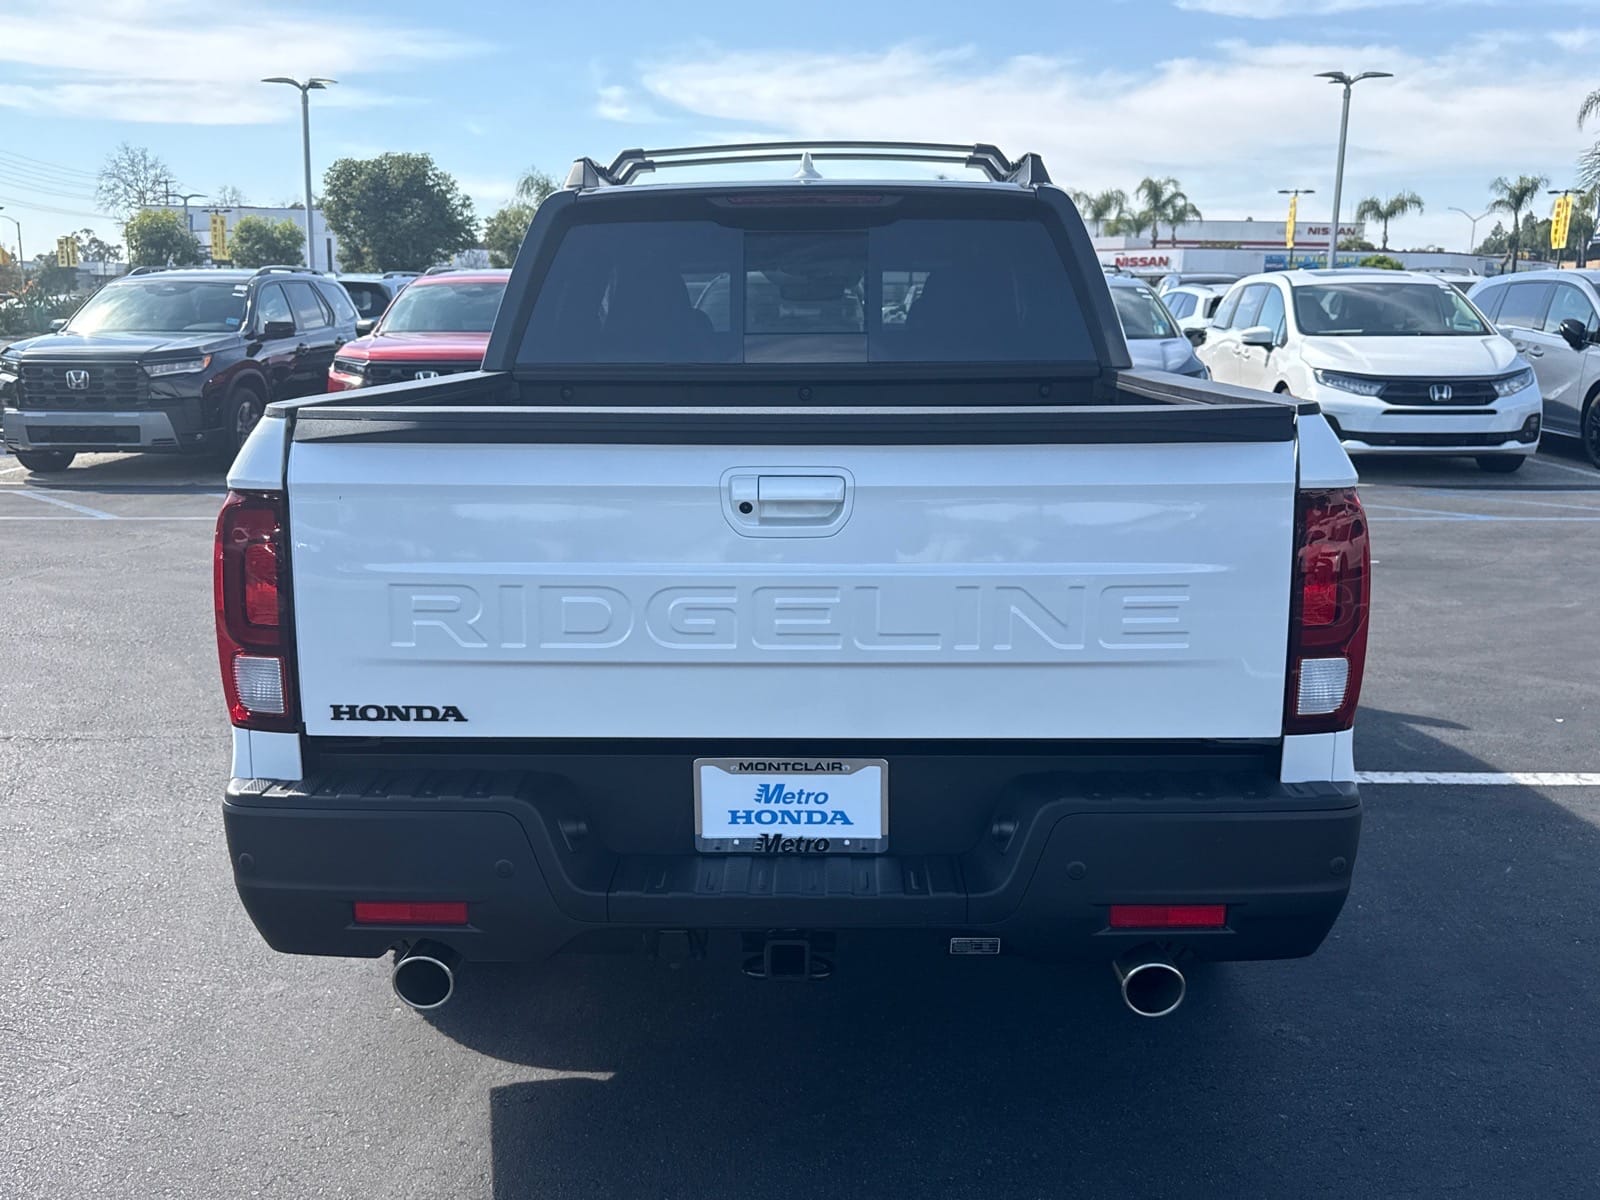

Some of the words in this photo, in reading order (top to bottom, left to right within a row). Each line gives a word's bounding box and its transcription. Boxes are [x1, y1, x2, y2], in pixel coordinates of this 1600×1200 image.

[1307, 226, 1356, 236] NISAN
[1115, 256, 1170, 267] NISSAN
[388, 583, 1191, 651] RIDGELINE
[329, 704, 469, 722] HONDA
[738, 761, 843, 772] MONTCLAIR
[754, 783, 829, 805] Metro
[727, 809, 854, 826] HONDA
[754, 833, 830, 853] Metro
